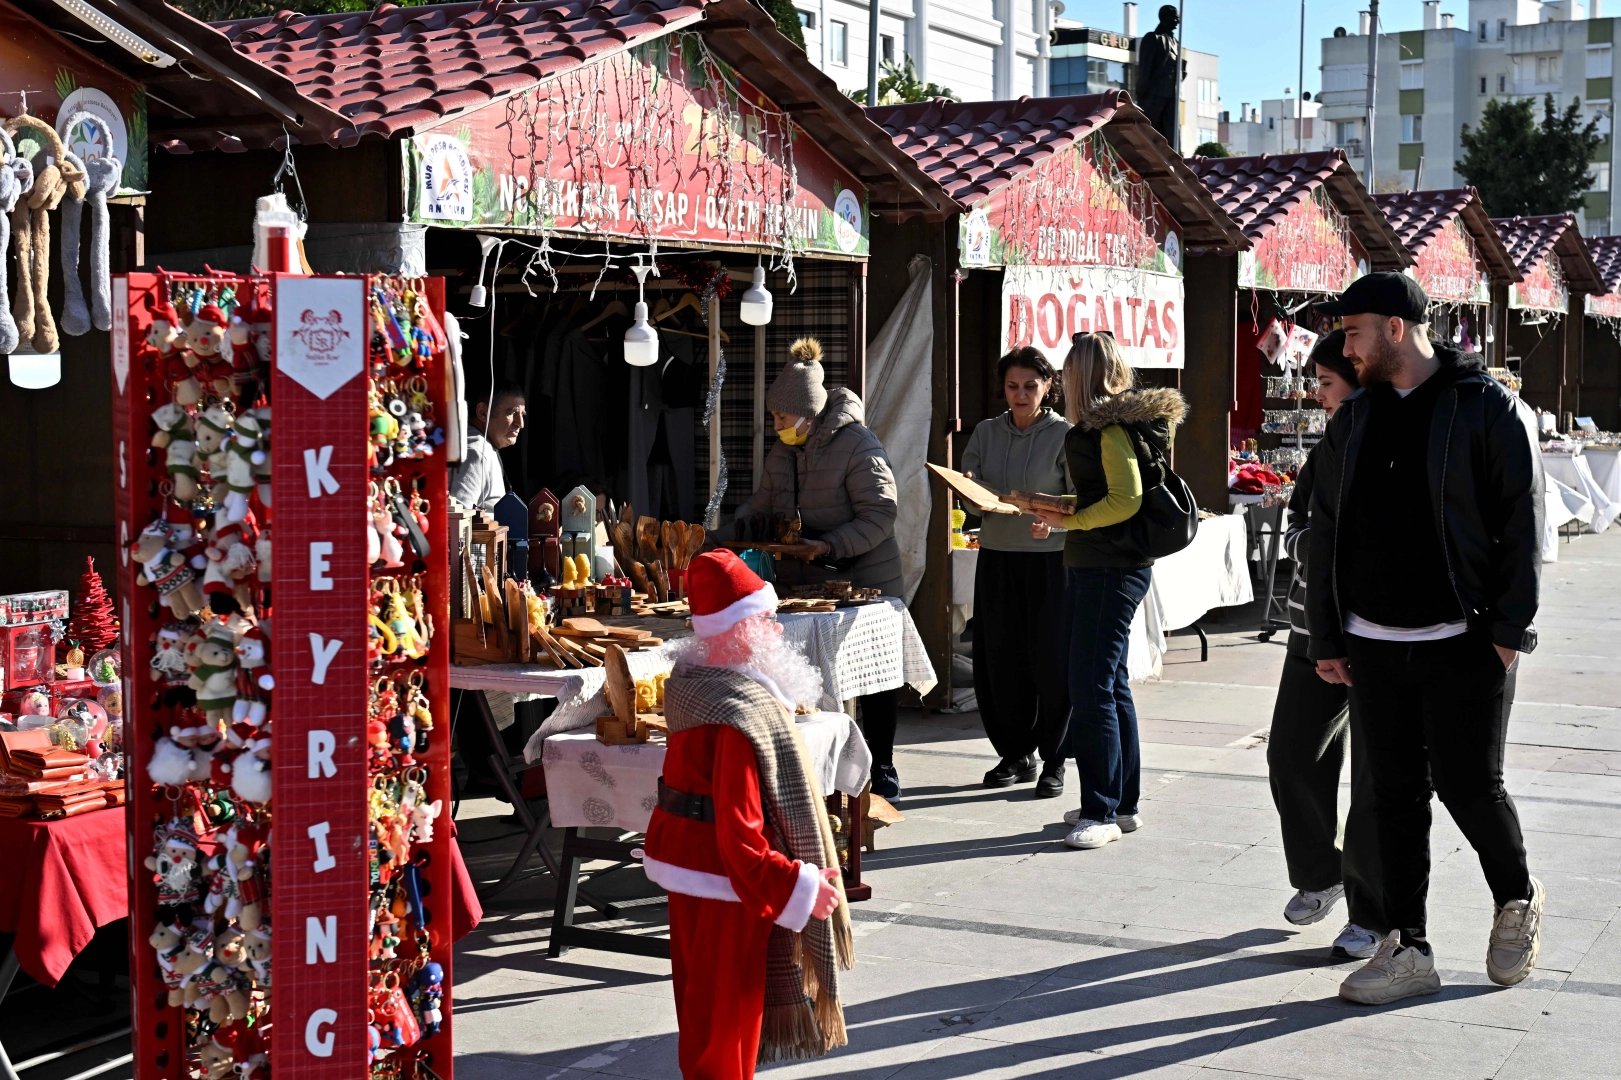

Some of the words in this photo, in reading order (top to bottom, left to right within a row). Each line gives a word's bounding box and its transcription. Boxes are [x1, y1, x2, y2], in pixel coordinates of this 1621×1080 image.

[682, 103, 765, 165] 2025
[428, 204, 465, 215] ANLYA
[626, 187, 689, 233] AHŞAP
[705, 188, 760, 233] ÖZLEM
[1009, 277, 1178, 363] DOĞALTAŞ
[369, 839, 380, 886] ELEMENTAL
